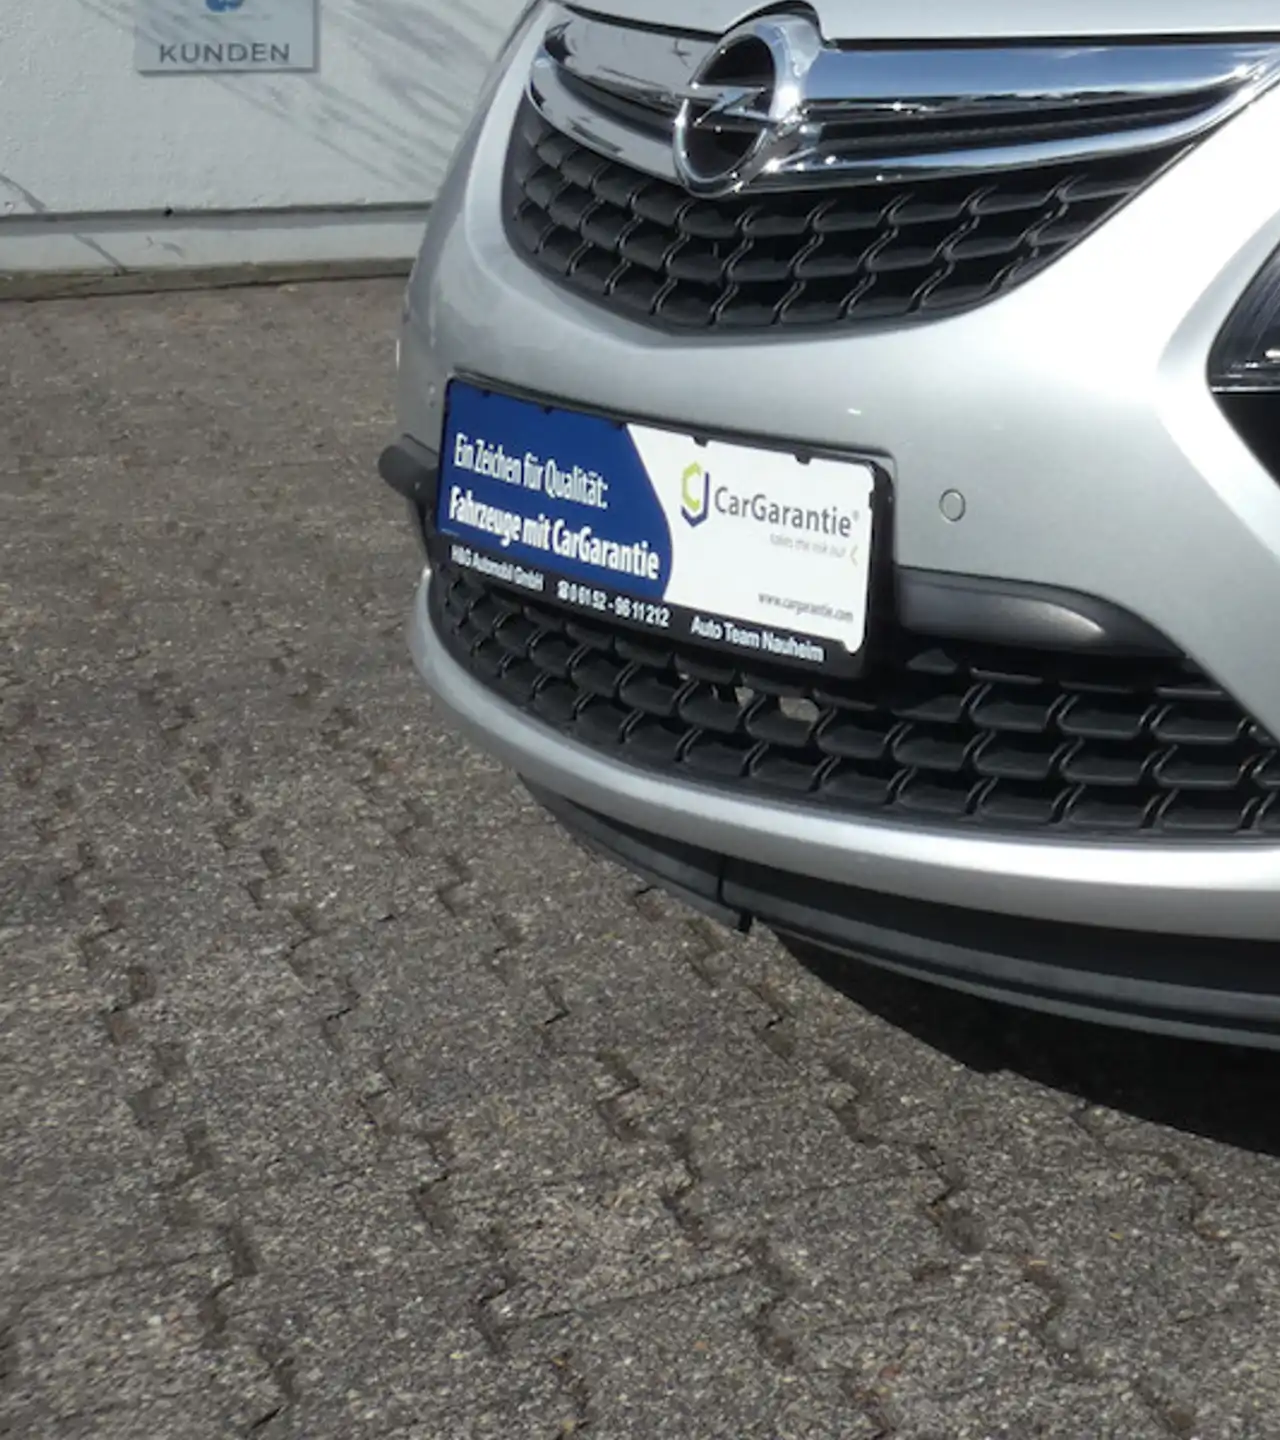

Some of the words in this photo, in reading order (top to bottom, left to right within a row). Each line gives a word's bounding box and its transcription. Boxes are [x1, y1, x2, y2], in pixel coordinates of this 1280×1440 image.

[159, 43, 290, 64] KUNDEN
[454, 432, 473, 470] Ein
[475, 439, 522, 486] Zeichen
[523, 452, 544, 491] für
[544, 459, 609, 509] Qualität:
[449, 485, 522, 547] Fahrzeuge
[522, 513, 550, 551] mit
[552, 518, 660, 580] CarGarantie
[714, 486, 852, 537] CarGarantie
[691, 616, 723, 640] Auto
[725, 623, 760, 648] Team
[762, 631, 825, 662] Nauheim
